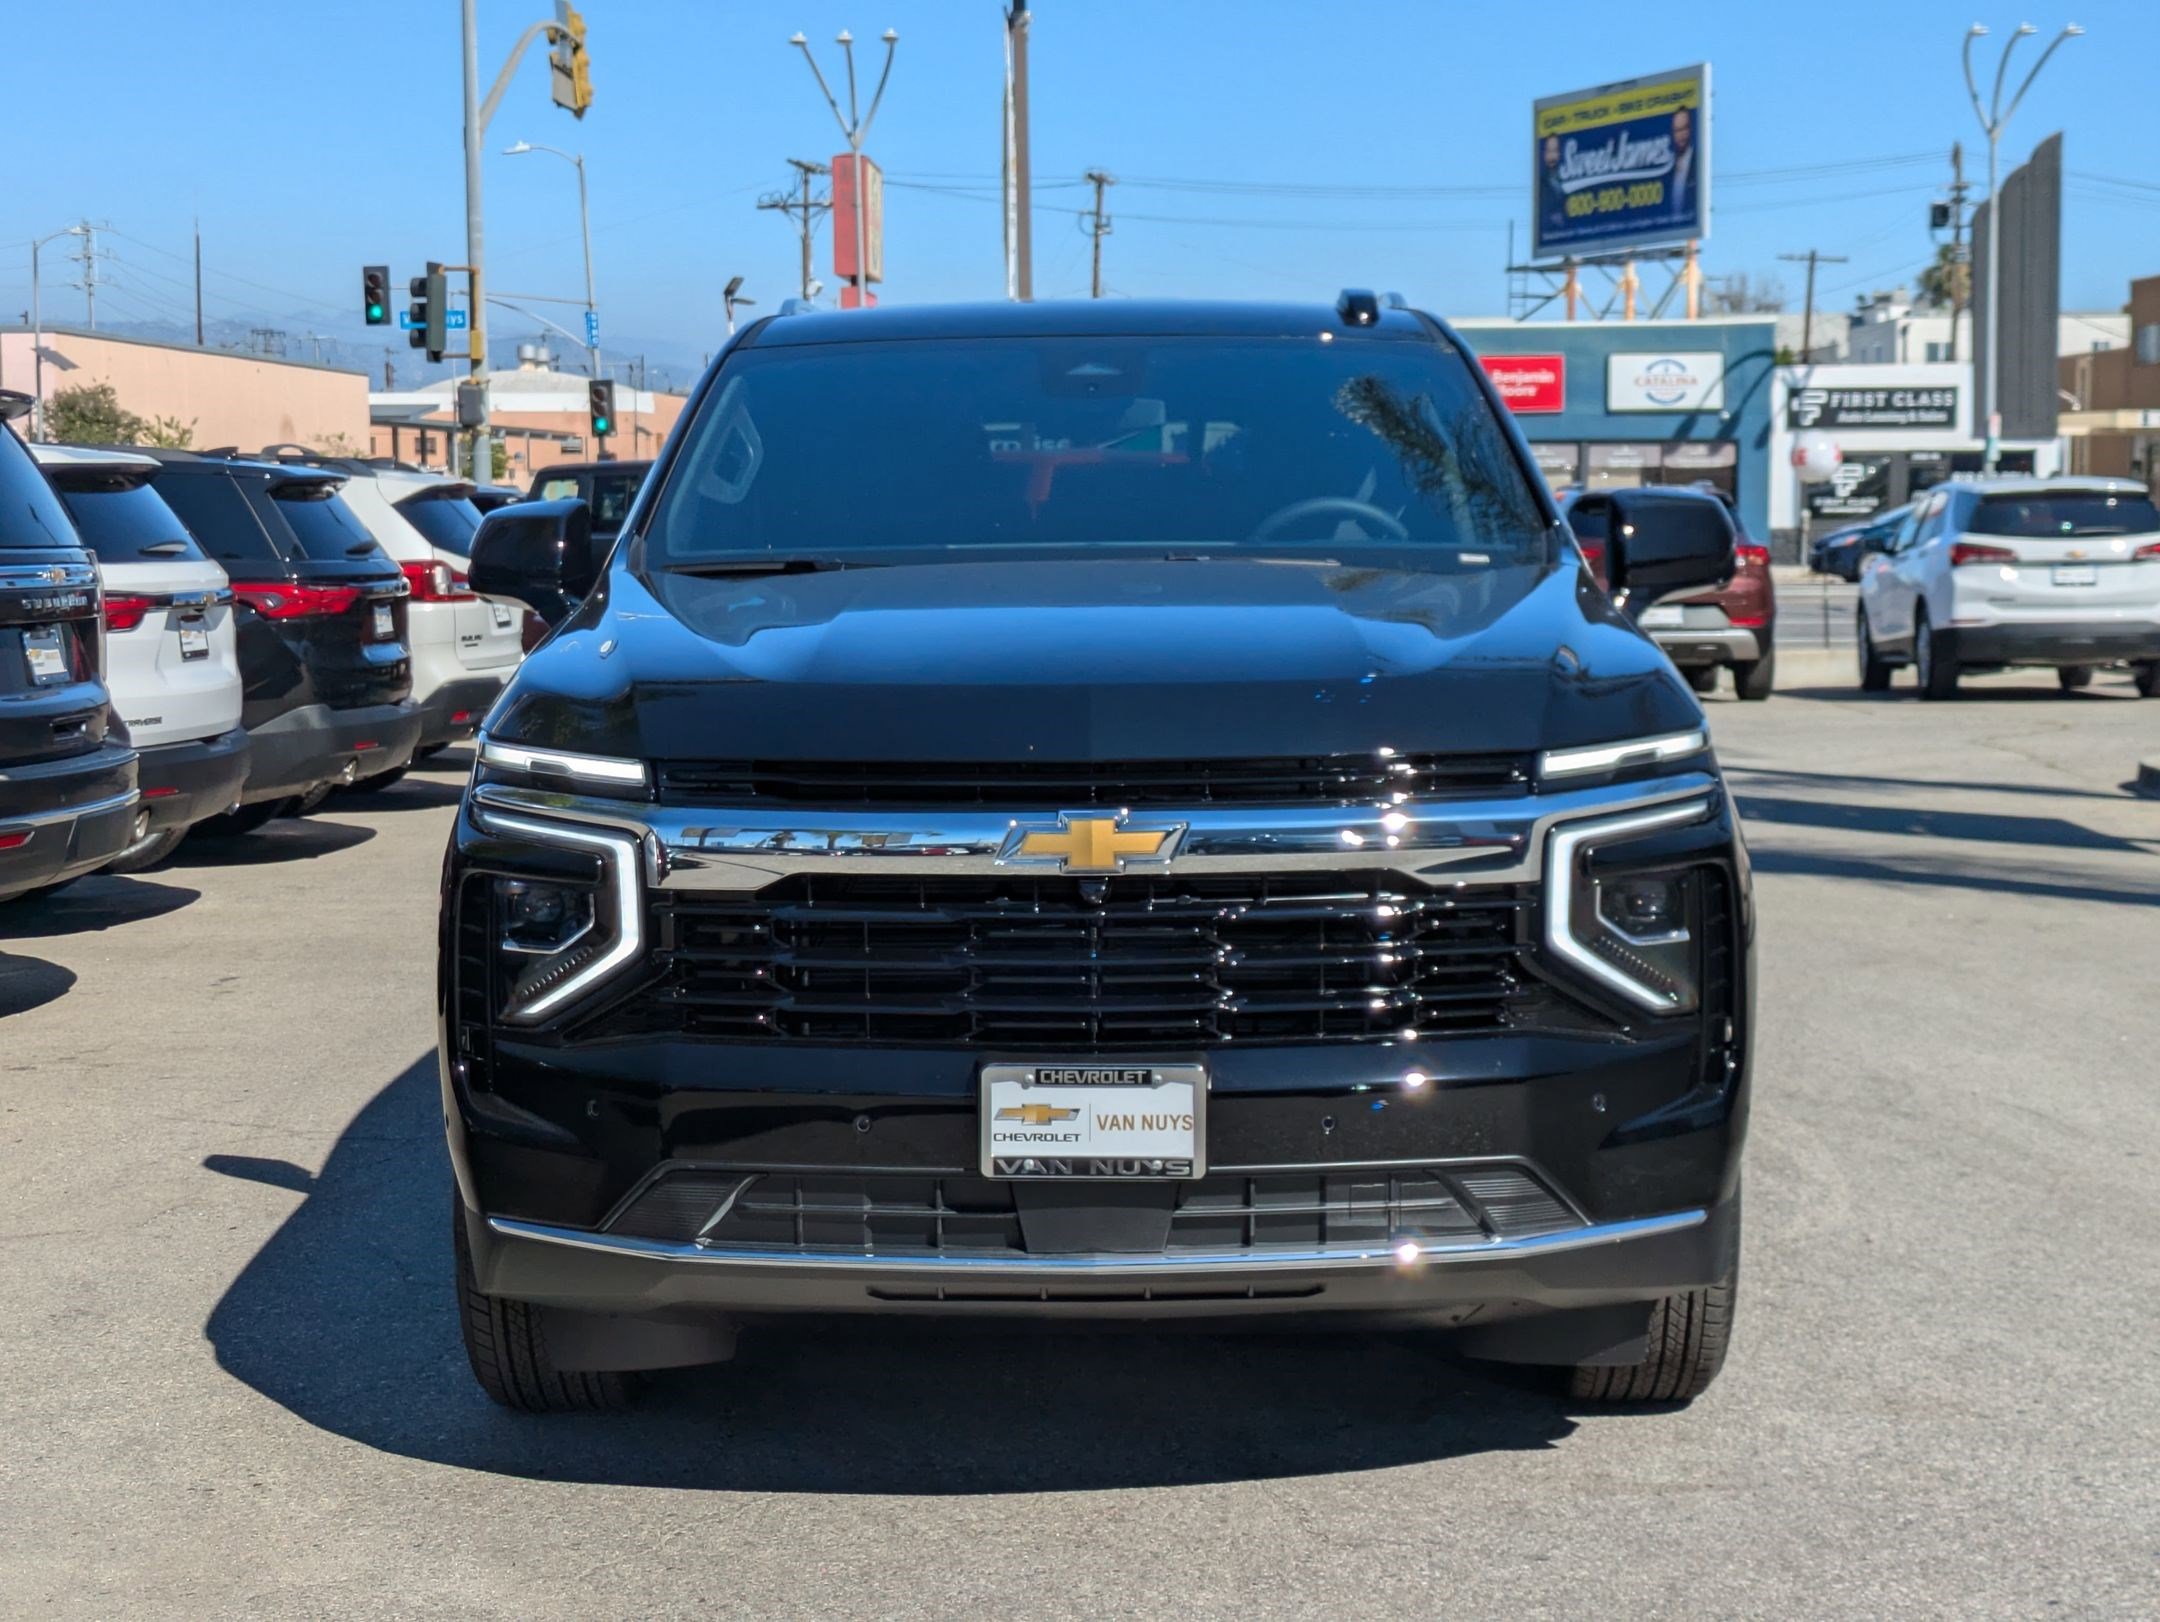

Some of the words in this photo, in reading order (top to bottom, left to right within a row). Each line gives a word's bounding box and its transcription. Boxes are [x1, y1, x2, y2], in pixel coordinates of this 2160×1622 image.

[1492, 368, 1556, 385] Benjamin
[1634, 374, 1698, 387] CATALINA
[1829, 391, 1888, 408] FIRST
[1892, 390, 1954, 407] CLASS
[1040, 1070, 1147, 1084] CHEVROLET
[1096, 1114, 1136, 1131] VAN
[1141, 1114, 1194, 1131] NUYS
[993, 1133, 1082, 1143] CHEVROLET
[996, 1159, 1073, 1175] VAN
[1089, 1159, 1191, 1176] NUYS
